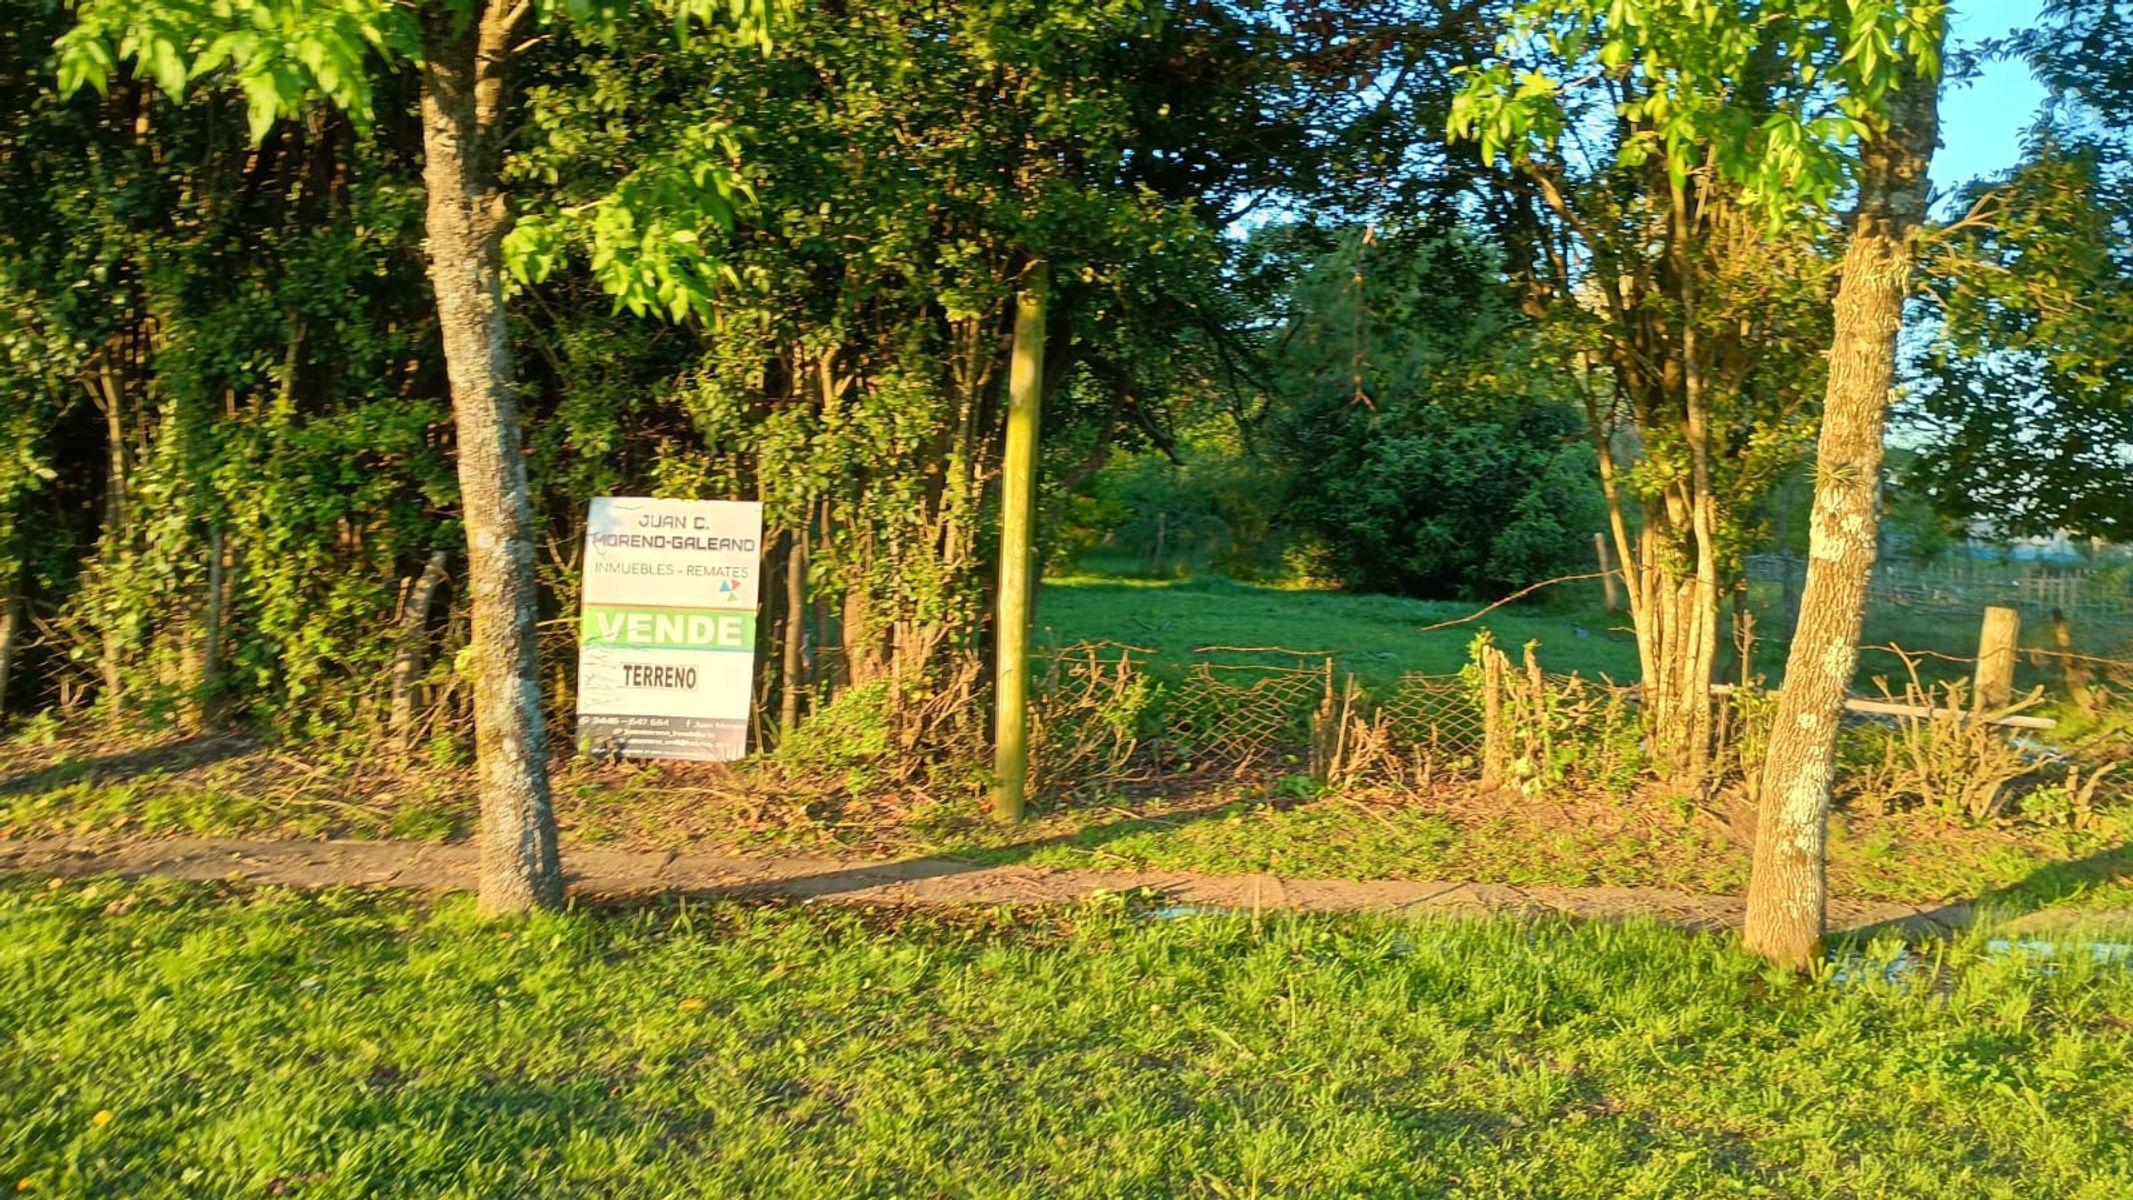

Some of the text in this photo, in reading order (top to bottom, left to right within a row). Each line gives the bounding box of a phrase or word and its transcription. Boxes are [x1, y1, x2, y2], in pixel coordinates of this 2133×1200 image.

[638, 514, 710, 530] JUAN C.
[592, 533, 756, 552] MORENO-GALEANO
[595, 561, 674, 576] INMUEBLES
[686, 564, 749, 579] REMATES
[595, 612, 743, 647] VENDE
[623, 664, 697, 690] TERRENO
